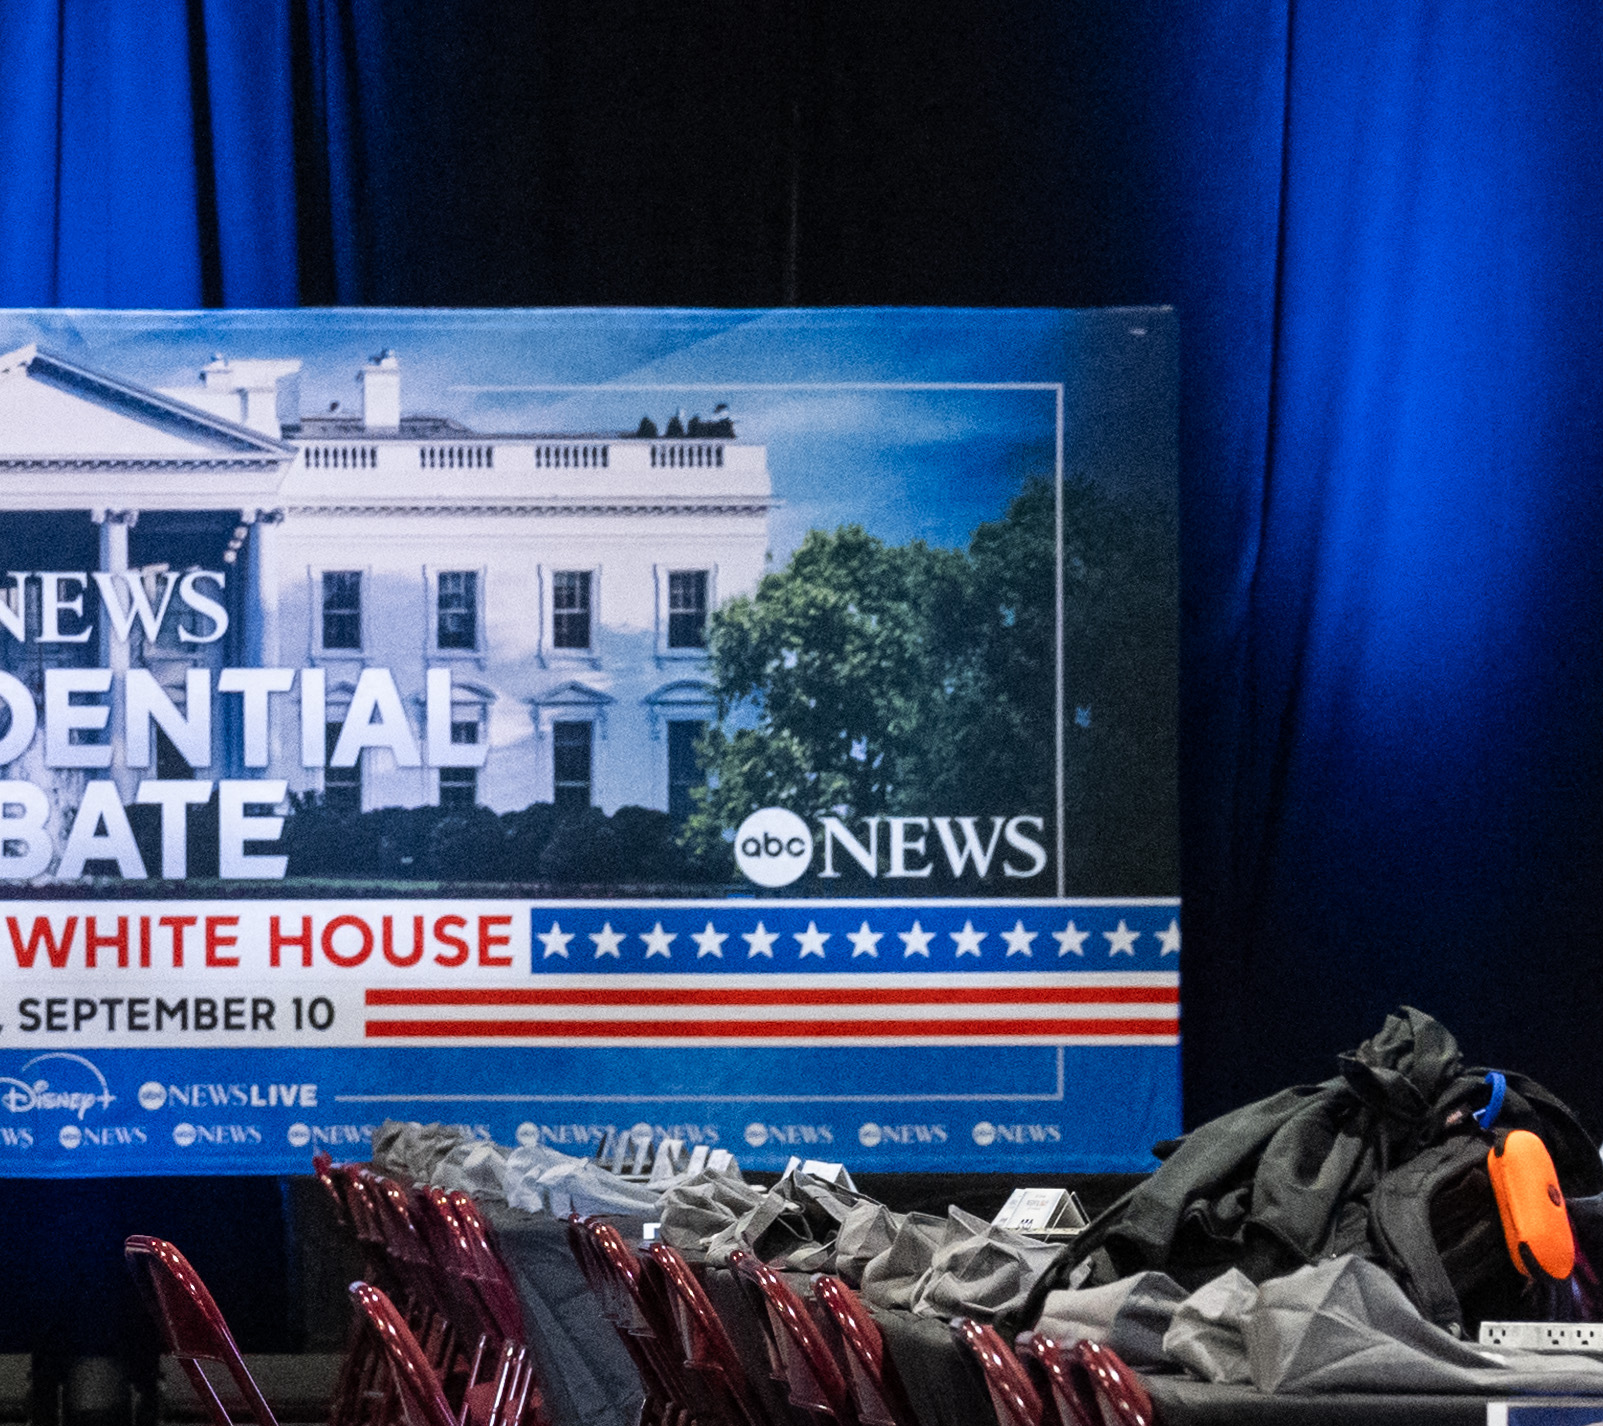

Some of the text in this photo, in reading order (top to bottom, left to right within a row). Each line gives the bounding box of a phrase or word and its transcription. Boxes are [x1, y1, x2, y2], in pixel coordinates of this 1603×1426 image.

[742, 815, 1048, 879] abc NEWS
[5, 914, 241, 969] WHITE
[269, 914, 514, 969] HOUSE
[18, 997, 276, 1032] SEPTEMBER
[292, 996, 335, 1032] 10
[83, 1125, 147, 1146] NEWS
[198, 1125, 262, 1145] NEWS
[768, 1124, 834, 1144] NEWS
[883, 1124, 948, 1144] NEWS
[996, 1124, 1061, 1144] NEWS
